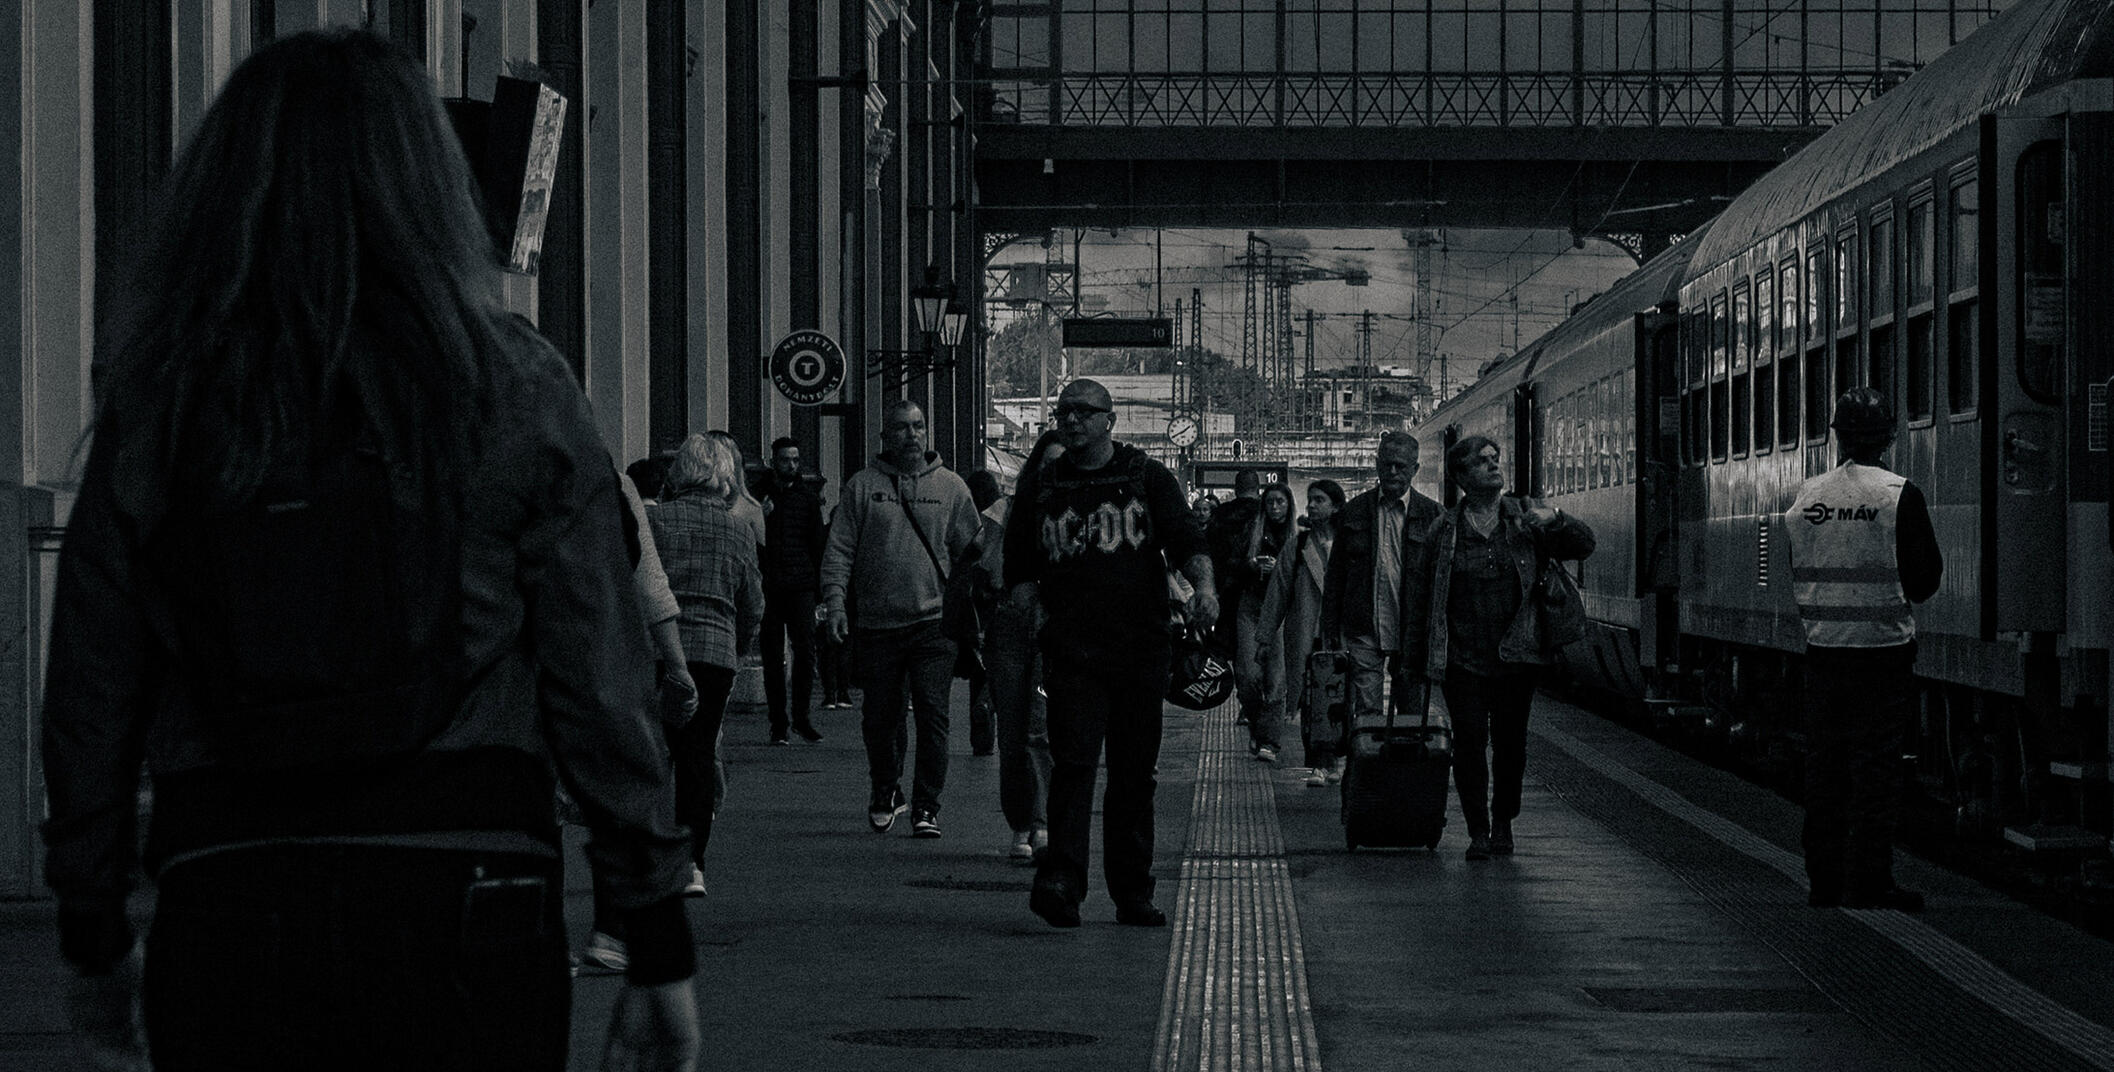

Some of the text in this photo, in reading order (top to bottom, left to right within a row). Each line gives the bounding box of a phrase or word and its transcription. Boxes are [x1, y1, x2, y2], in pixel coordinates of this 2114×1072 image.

[1152, 327, 1166, 338] 10
[783, 335, 832, 351] NEMZETI
[801, 362, 814, 375] T
[1266, 472, 1278, 484] 10
[1837, 504, 1879, 521] MÁV
